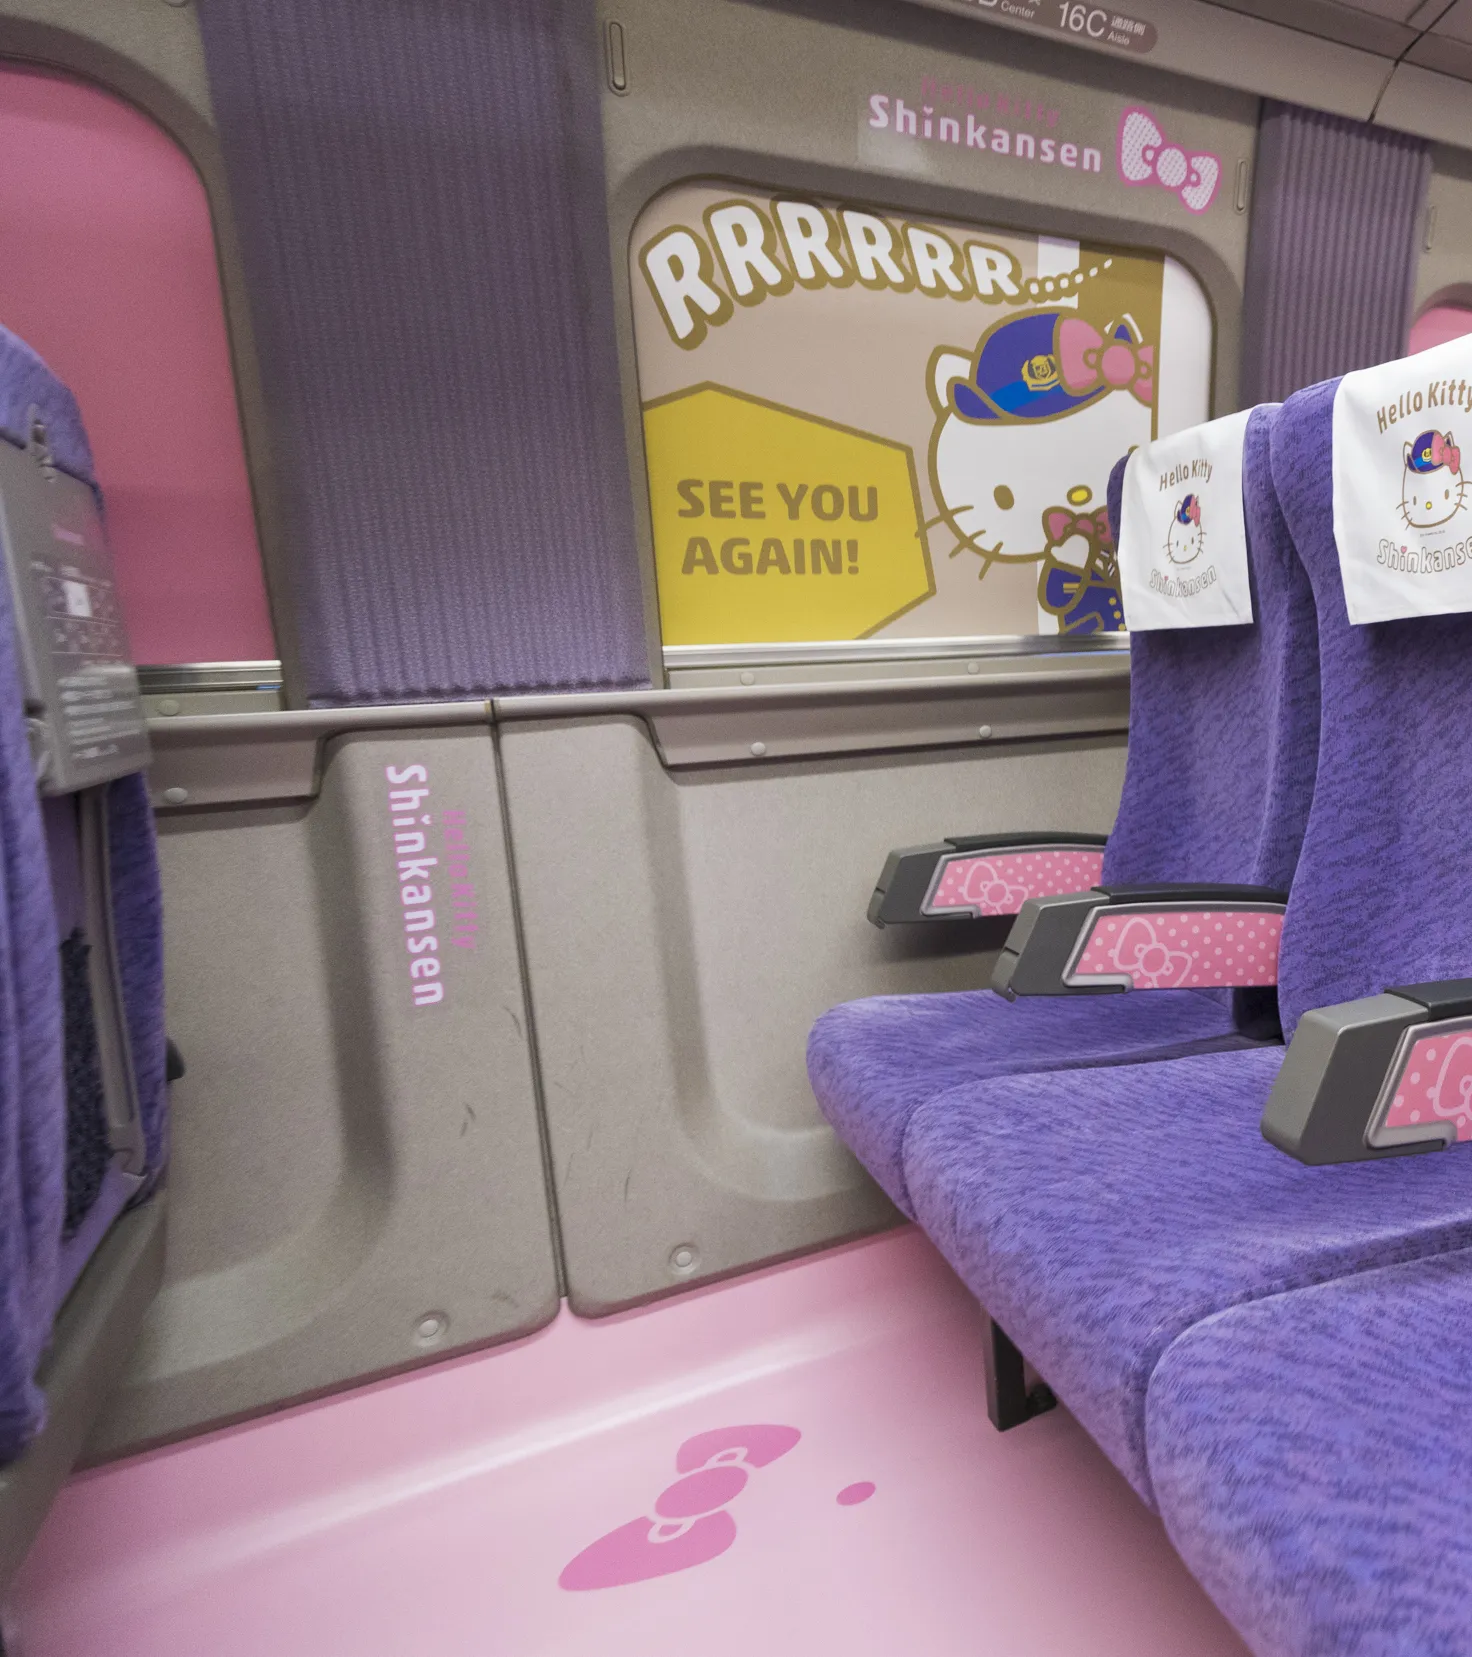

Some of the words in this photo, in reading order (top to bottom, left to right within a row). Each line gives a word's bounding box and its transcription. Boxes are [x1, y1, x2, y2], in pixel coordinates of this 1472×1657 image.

[1058, 2, 1108, 38] 16C
[869, 94, 1101, 173] Shinkansen
[1376, 389, 1423, 434] Hello
[1159, 464, 1189, 492] Hello
[1191, 458, 1213, 484] Kitty
[676, 478, 767, 520] SEE
[776, 482, 879, 522] YOU
[681, 536, 860, 576] AGAIN!
[1150, 565, 1217, 598] Shinkansen
[442, 810, 471, 878] Hello
[386, 764, 445, 1006] Shinkansen
[451, 883, 480, 950] Kitty
